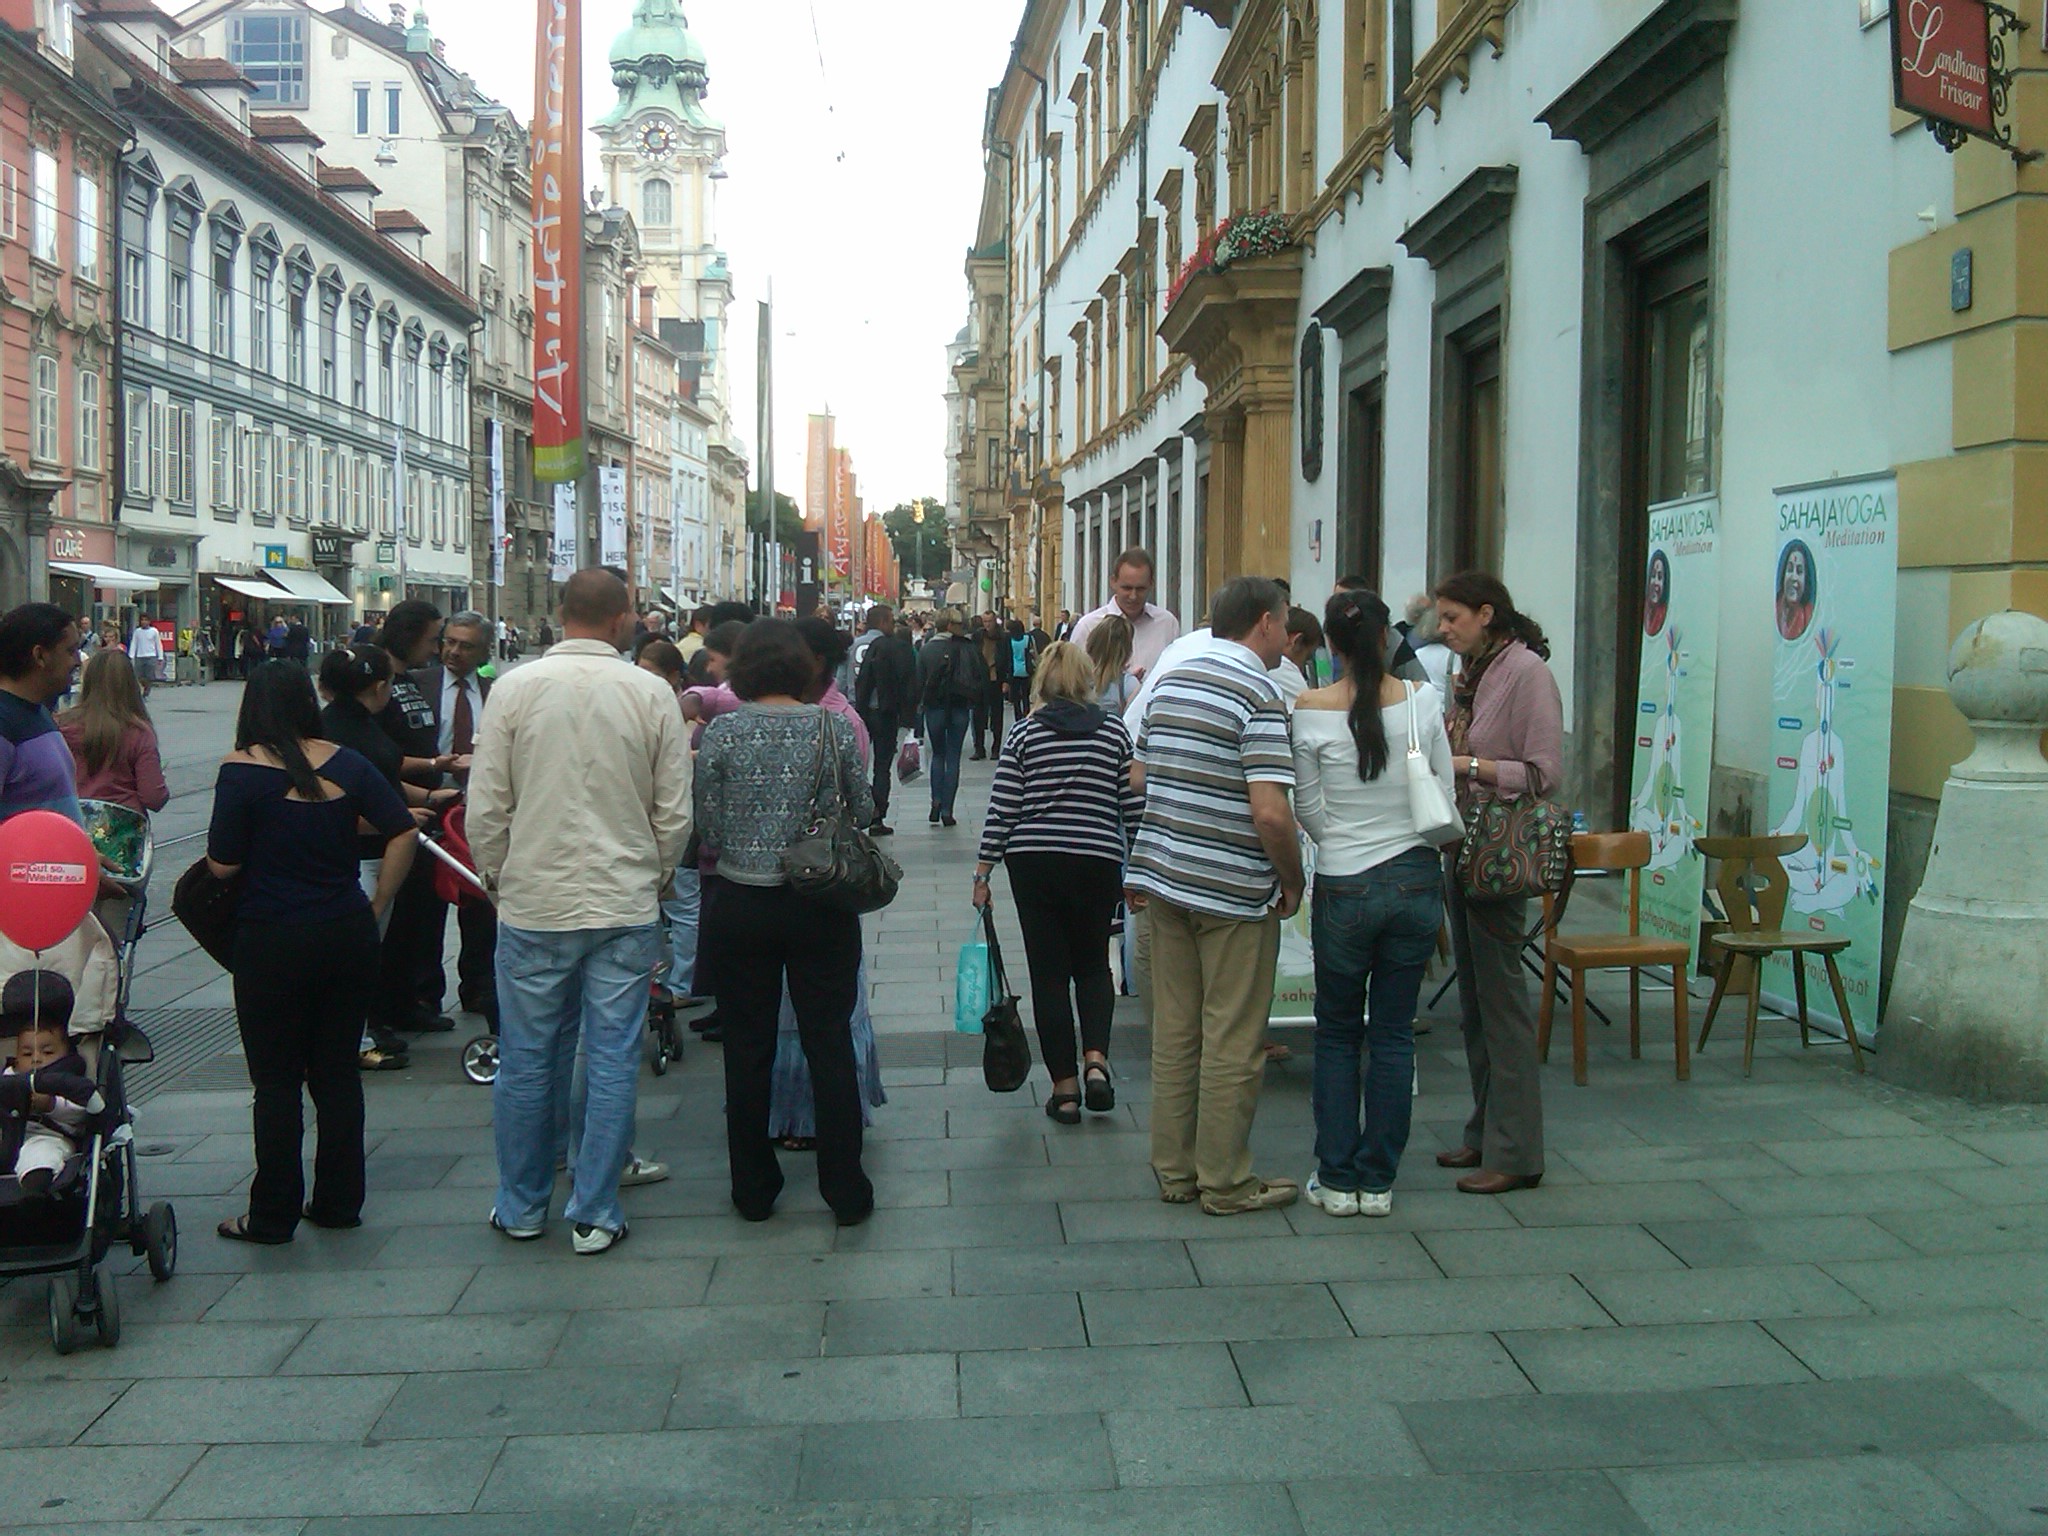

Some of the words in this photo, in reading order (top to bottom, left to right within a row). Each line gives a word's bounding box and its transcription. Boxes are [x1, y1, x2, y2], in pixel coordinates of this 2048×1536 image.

[1901, 0, 1986, 85] Landhaus
[1939, 75, 1983, 111] Friseur
[1649, 509, 1715, 544] SAHAJAYOGA
[1779, 494, 1887, 537] SAHAJAYOGA
[1824, 529, 1886, 549] Meditation
[27, 872, 63, 882] Weiter
[28, 864, 47, 873] Gut
